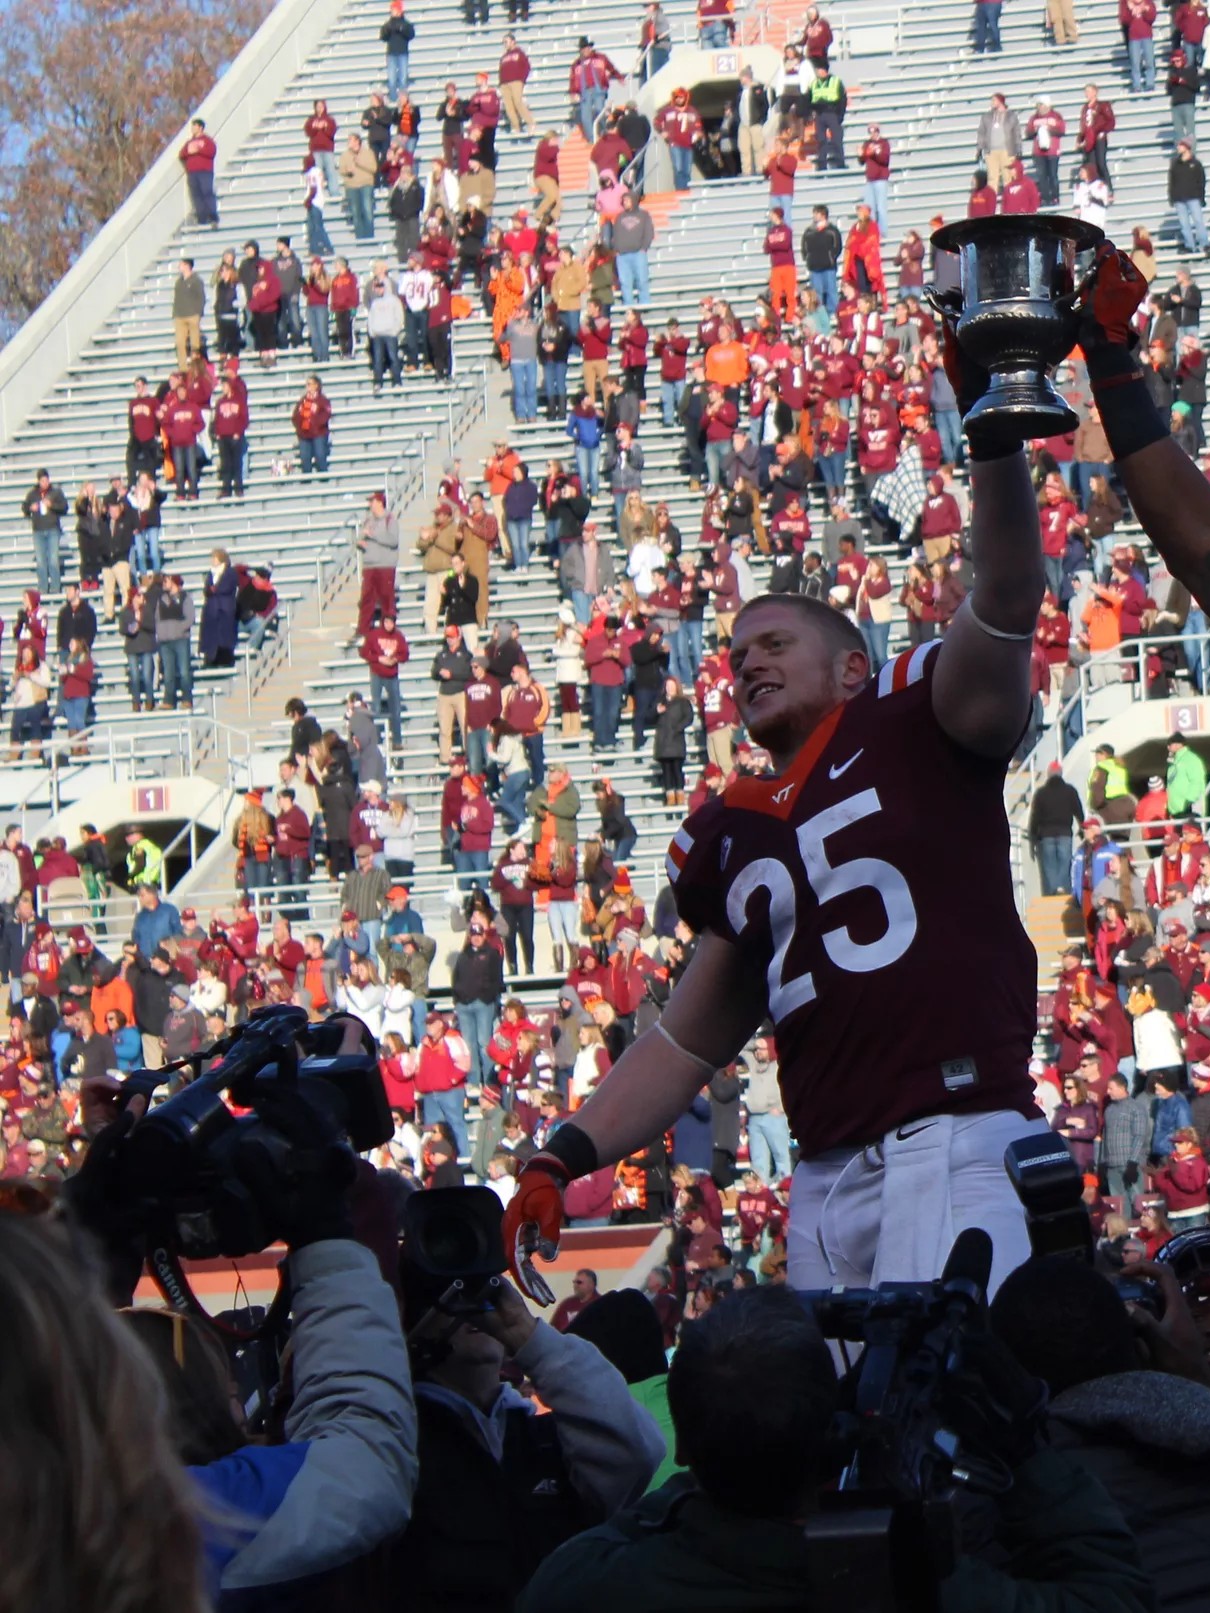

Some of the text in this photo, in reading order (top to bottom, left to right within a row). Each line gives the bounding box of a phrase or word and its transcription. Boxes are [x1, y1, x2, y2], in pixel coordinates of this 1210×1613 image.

[718, 55, 736, 71] 21
[1049, 512, 1061, 531] 7
[1178, 709, 1191, 727] 3
[146, 790, 155, 808] 1
[772, 783, 795, 804] VT
[726, 787, 917, 1025] 25
[153, 1247, 189, 1309] Canon
